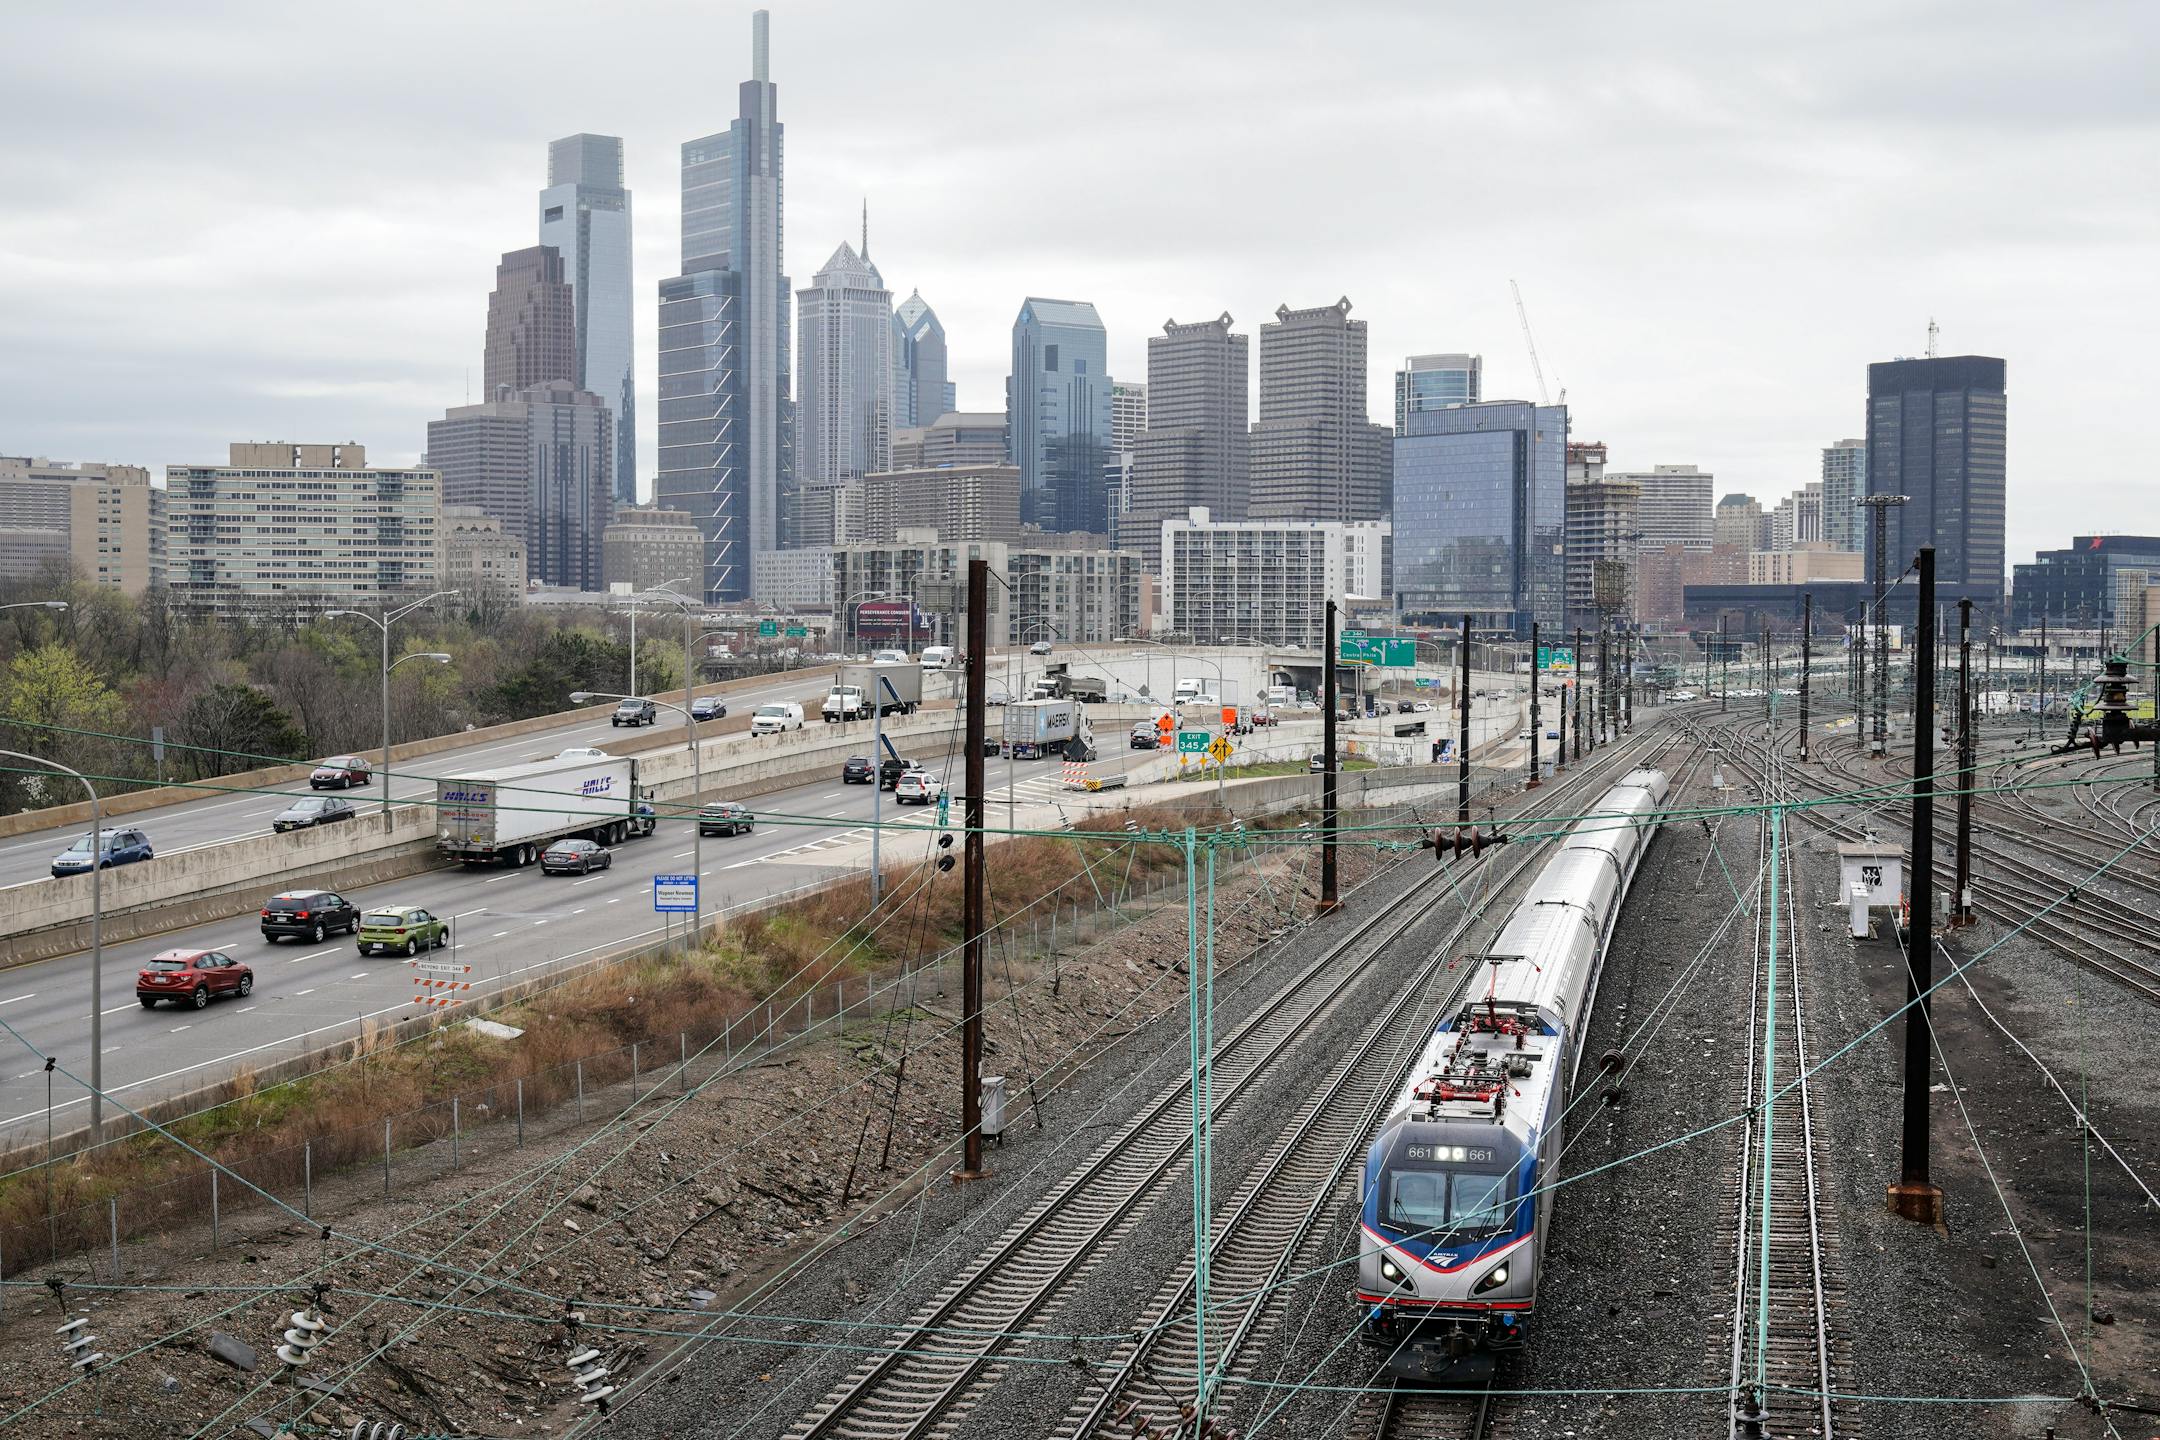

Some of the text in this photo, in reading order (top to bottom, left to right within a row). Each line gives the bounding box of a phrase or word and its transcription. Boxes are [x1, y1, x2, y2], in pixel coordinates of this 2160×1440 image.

[1047, 712, 1071, 729] MAERSK
[1179, 741, 1199, 749] 345
[1408, 1146, 1431, 1159] 661
[1469, 1149, 1492, 1161] 661
